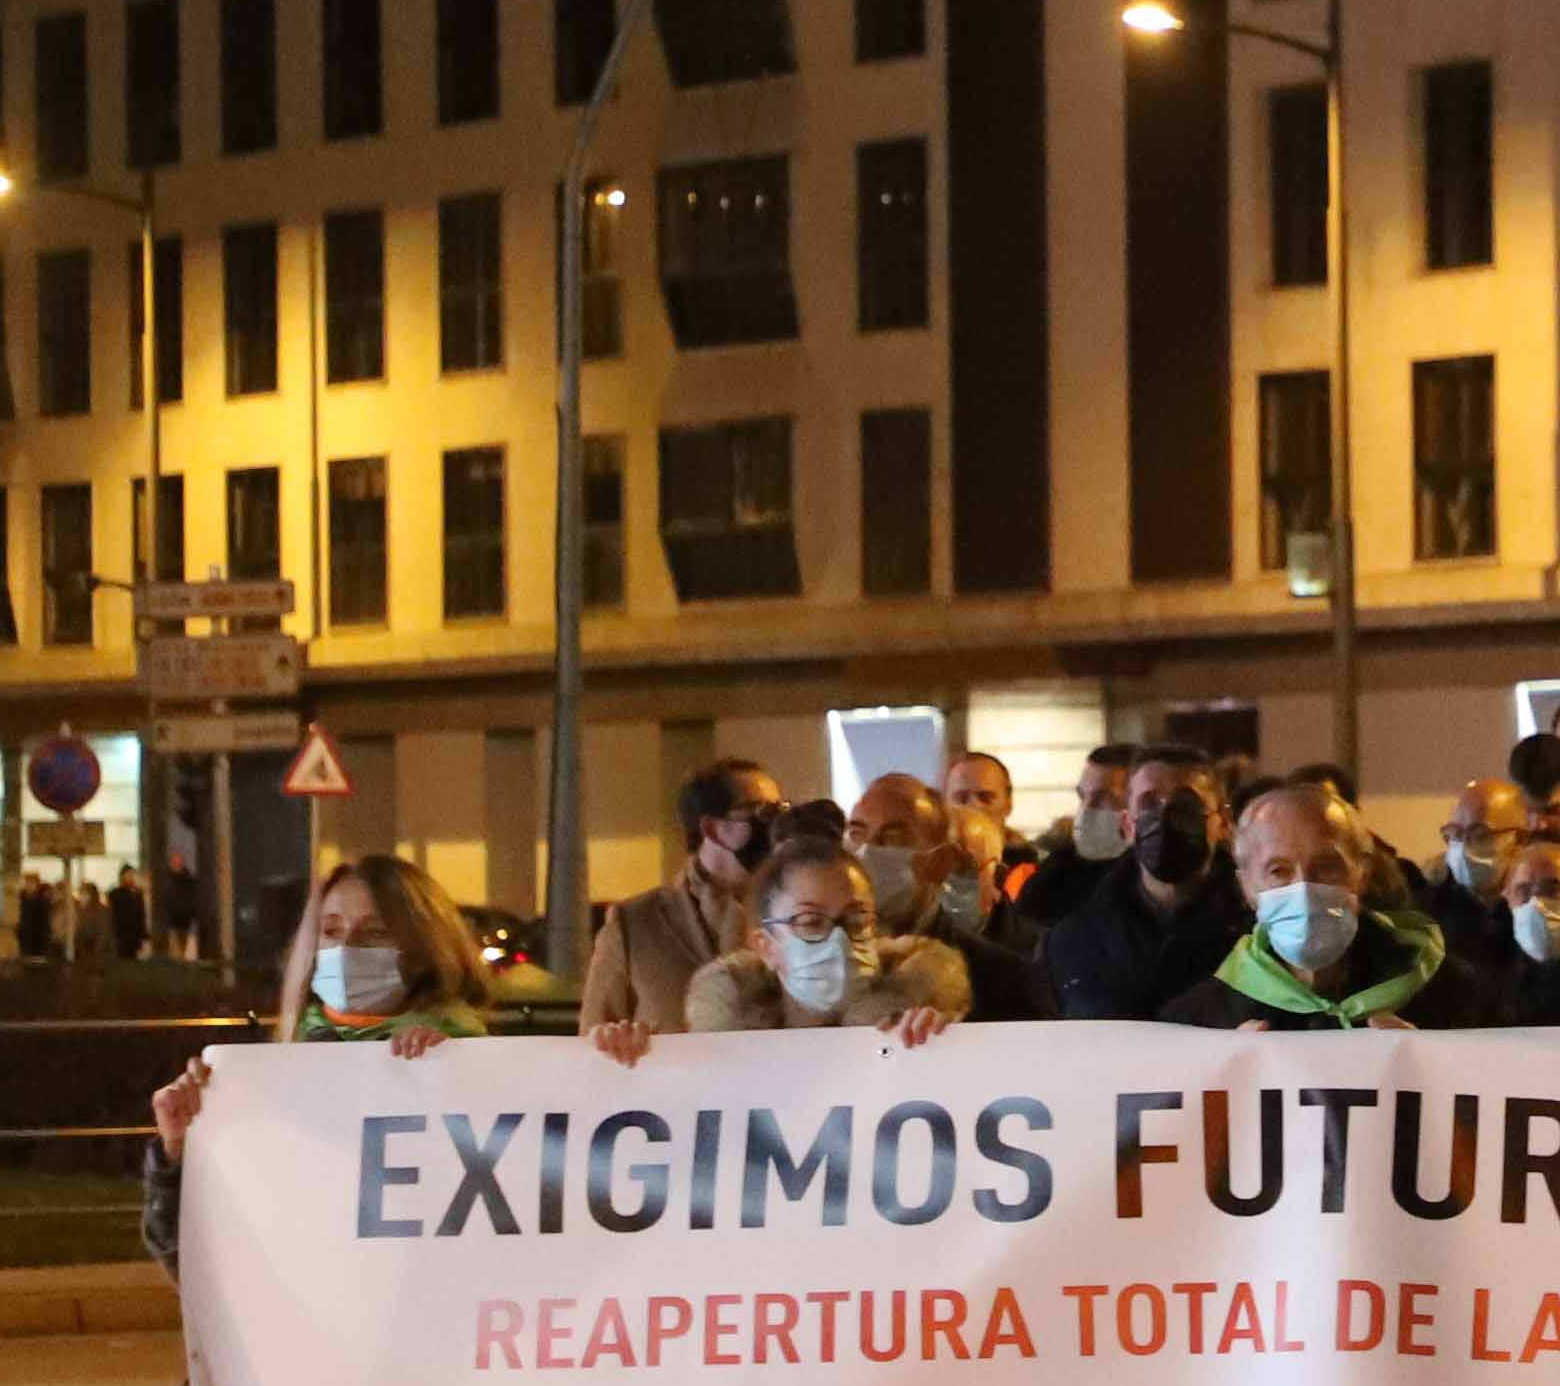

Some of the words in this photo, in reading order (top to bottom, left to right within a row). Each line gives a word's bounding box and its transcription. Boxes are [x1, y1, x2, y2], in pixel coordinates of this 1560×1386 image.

[357, 1099, 1053, 1238] EXIGIMOS
[476, 1287, 1038, 1369] REAPERTURA
[1062, 1283, 1307, 1357] TOTAL
[1336, 1276, 1440, 1361] DE
